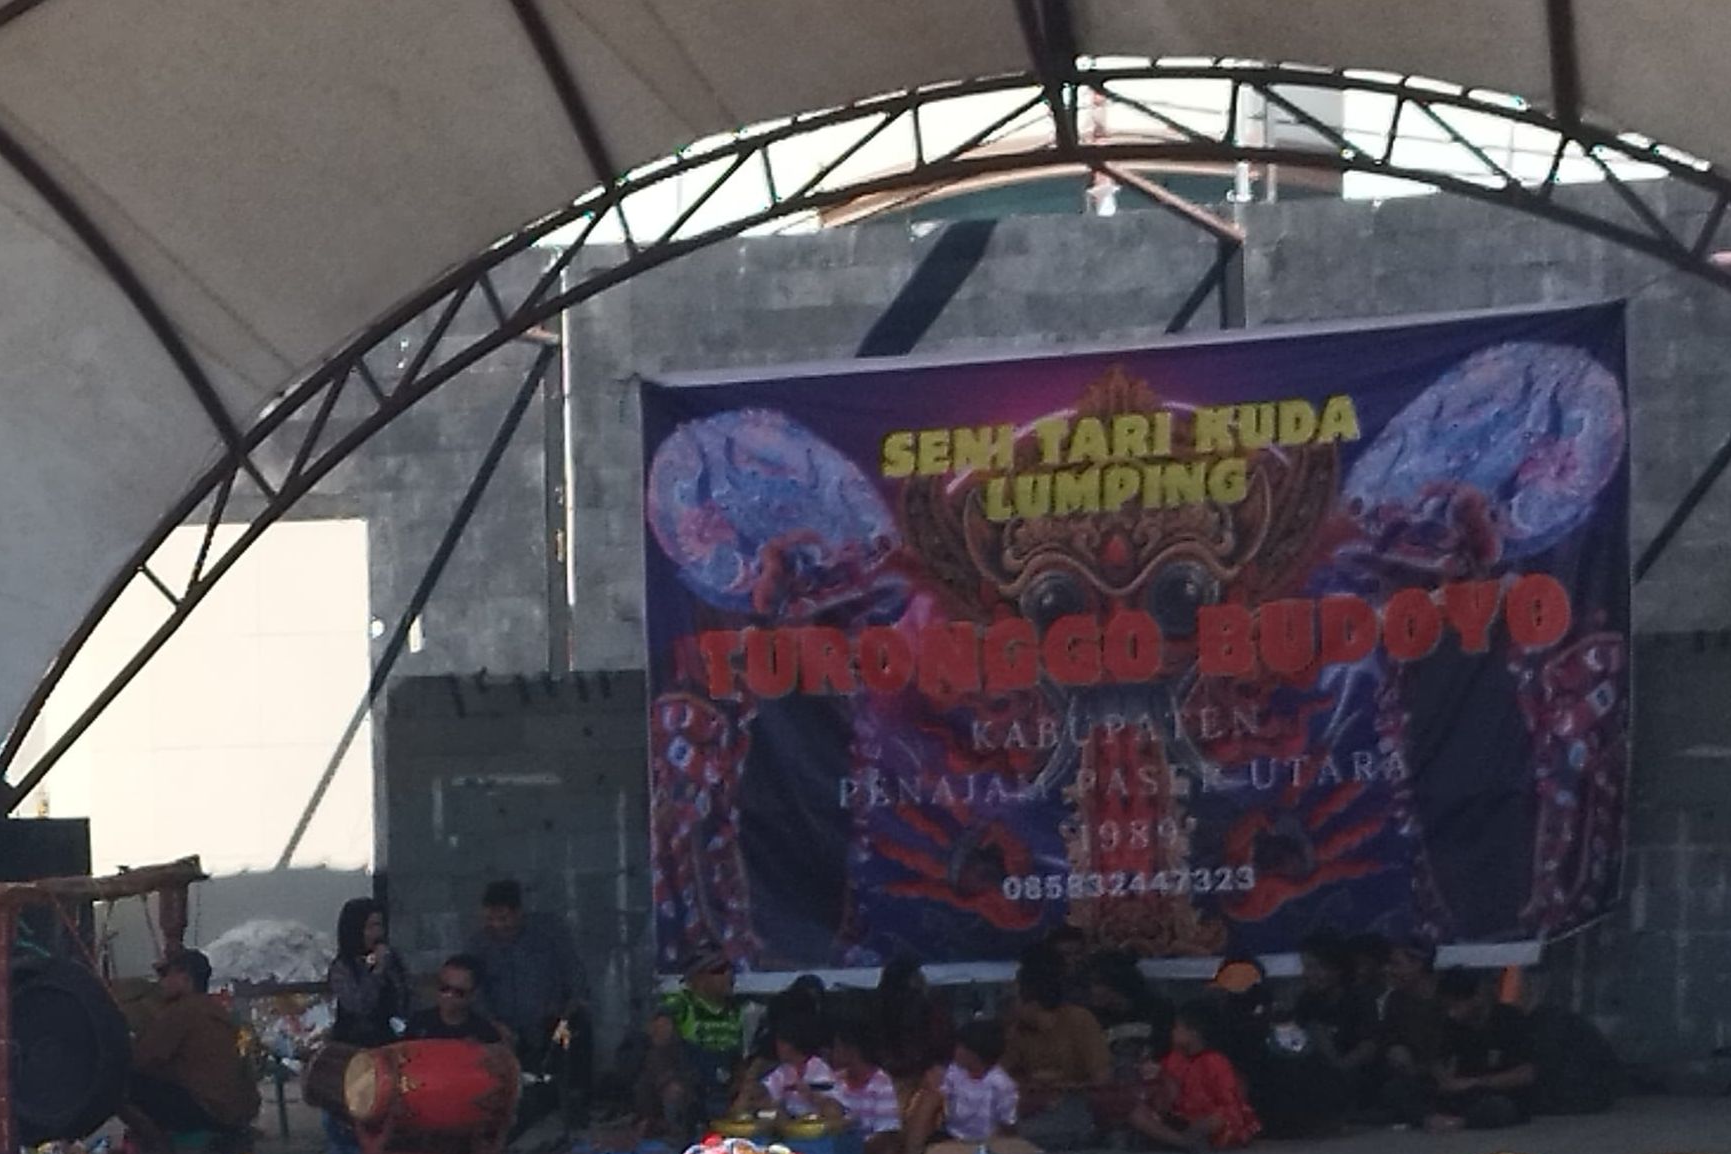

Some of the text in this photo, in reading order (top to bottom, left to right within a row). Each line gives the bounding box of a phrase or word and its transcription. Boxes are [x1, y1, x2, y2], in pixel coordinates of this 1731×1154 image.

[882, 395, 1361, 478] SENI TARI KUDA
[984, 457, 1247, 523] LUMPING
[699, 573, 1571, 699] TURONGGO BUDOYO
[971, 703, 1262, 751] KABUPATEN
[1249, 750, 1409, 790] UTARA
